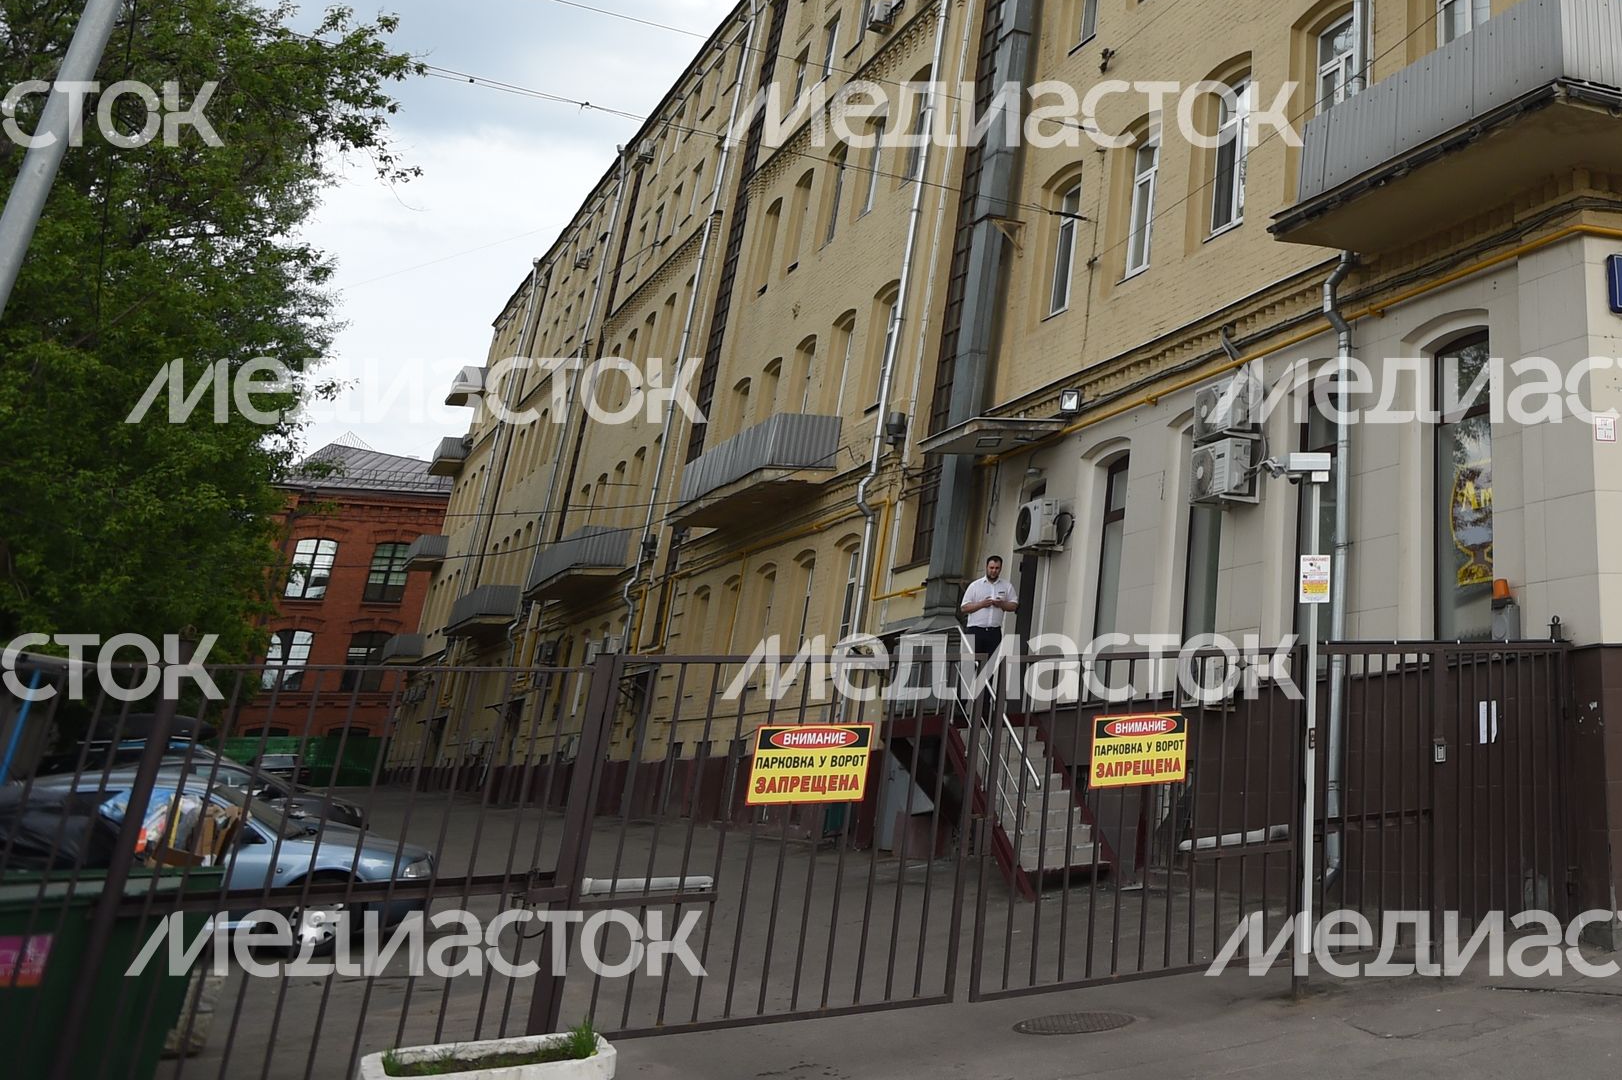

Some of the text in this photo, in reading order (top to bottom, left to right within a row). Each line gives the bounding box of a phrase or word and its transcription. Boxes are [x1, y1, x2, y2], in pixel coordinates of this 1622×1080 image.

[1115, 720, 1167, 734] ВНИМАНИЕ
[783, 732, 847, 745] ВНИМАНИЕ
[1094, 740, 1184, 756] ПАРКОВКА У ВОРОТ
[755, 754, 866, 769] ПАРКОВКА У ВОРОТ
[1095, 757, 1182, 779] ЗАПРЕЩЕНА
[754, 774, 859, 794] ЗАПРЕЩЕНА
